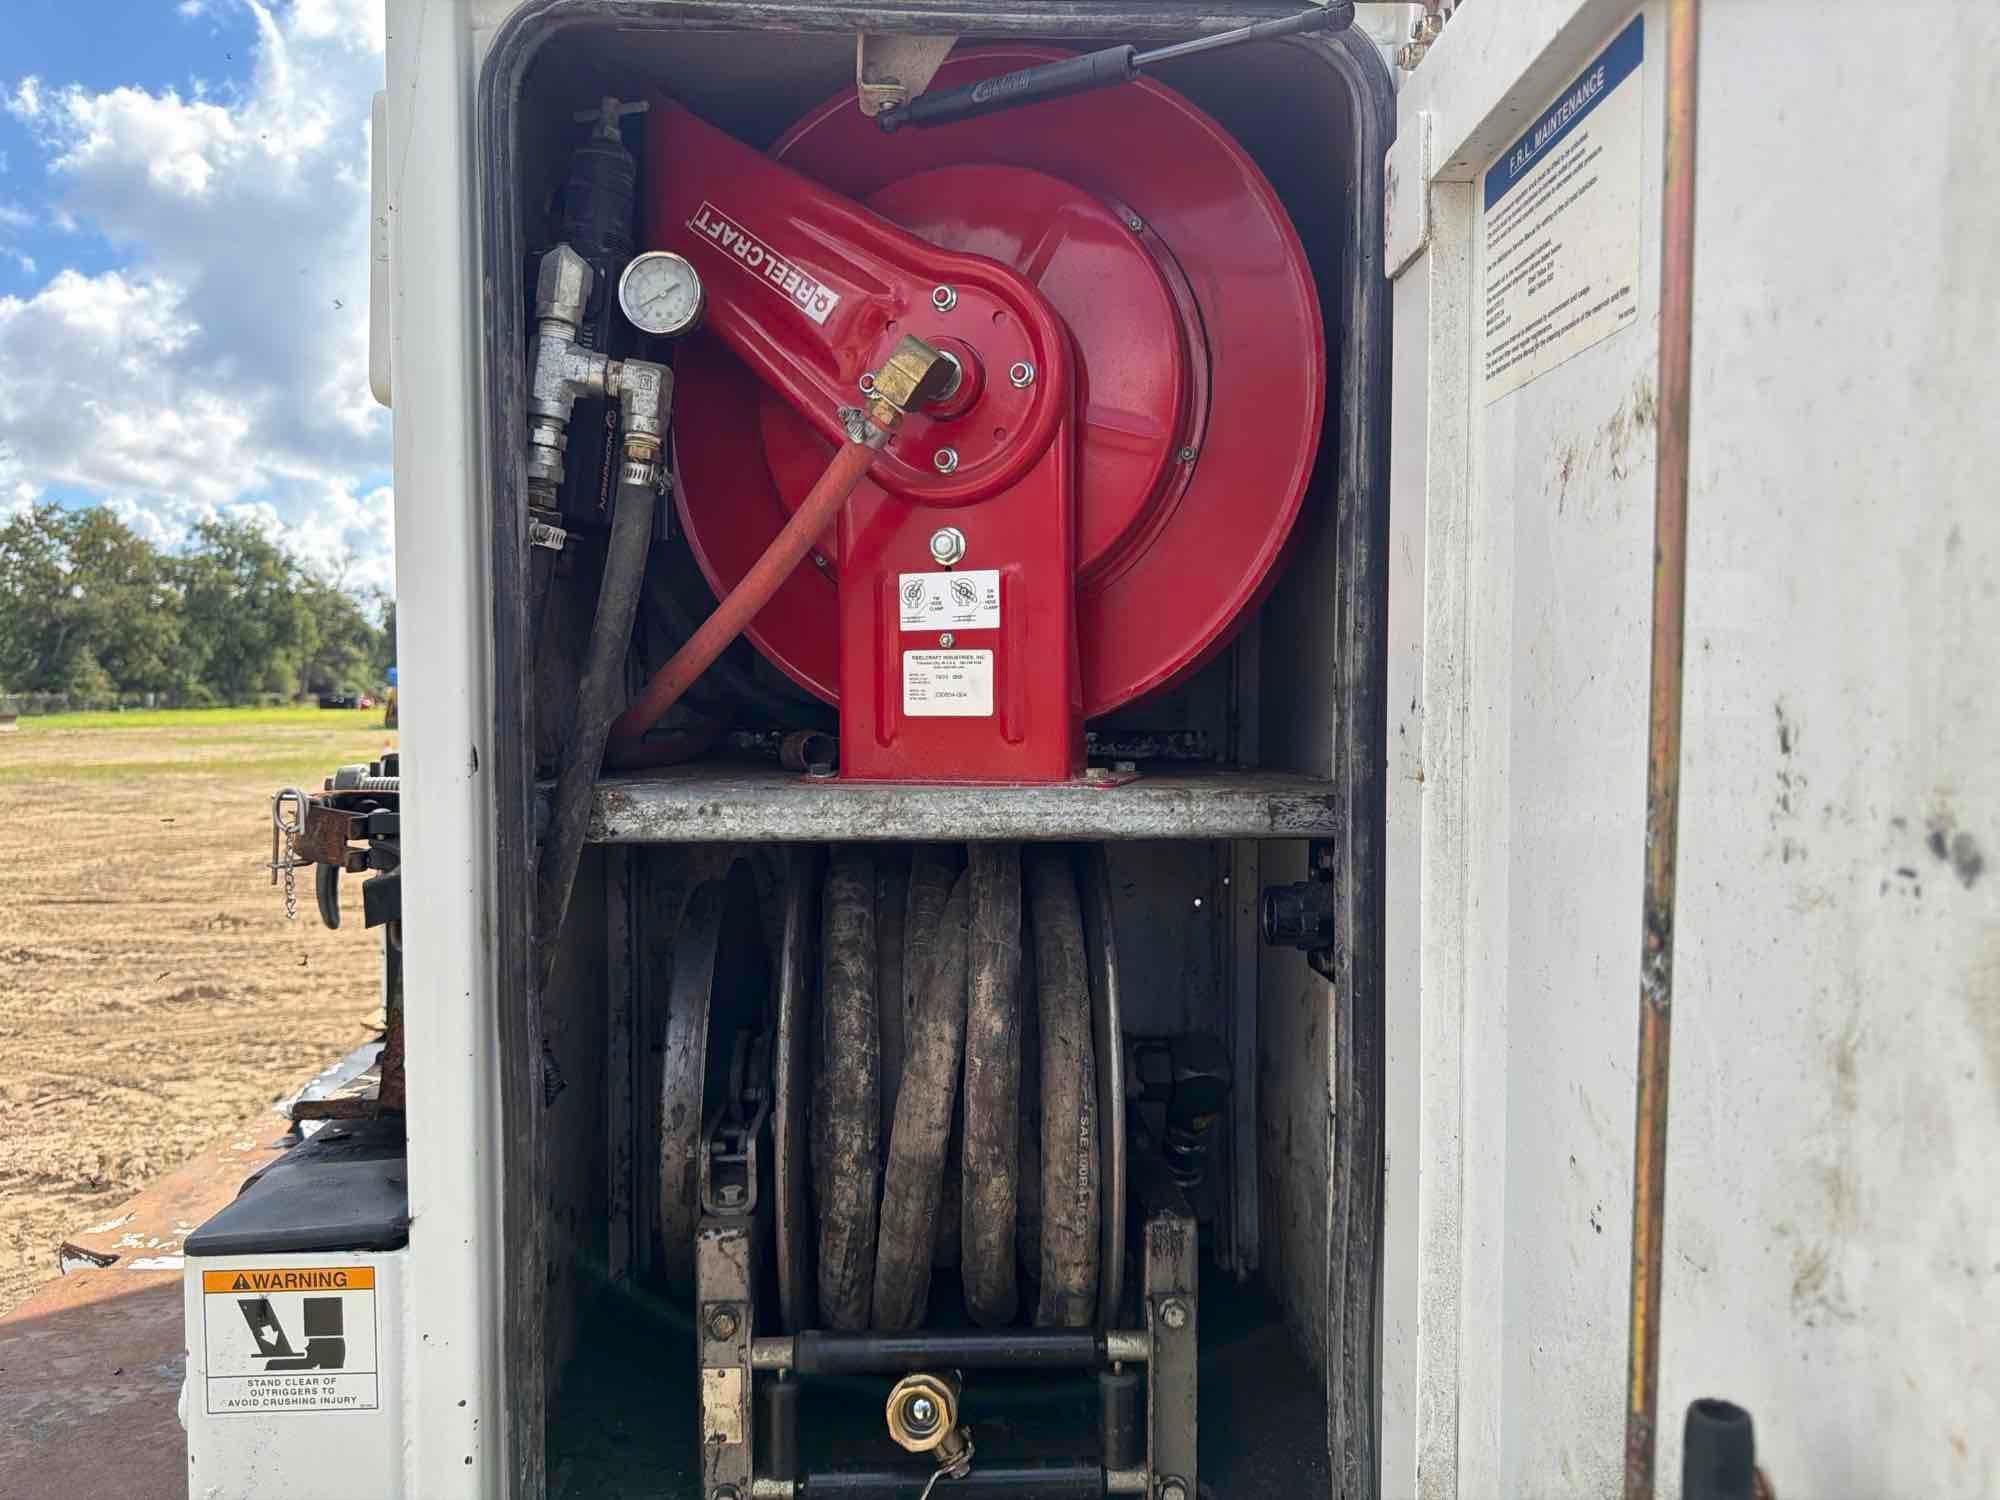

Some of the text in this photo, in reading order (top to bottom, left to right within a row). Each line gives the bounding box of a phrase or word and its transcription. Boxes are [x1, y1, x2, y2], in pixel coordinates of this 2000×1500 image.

[1534, 65, 1605, 149] MAINTENANCE
[694, 210, 817, 309] REELCRAFT
[252, 1271, 348, 1290] WARNING
[247, 1377, 337, 1387] STAND CLEAR OF
[250, 1387, 335, 1397] OUTRIGGERS TO
[228, 1396, 358, 1407] AVOID CRUSHING INJURY
